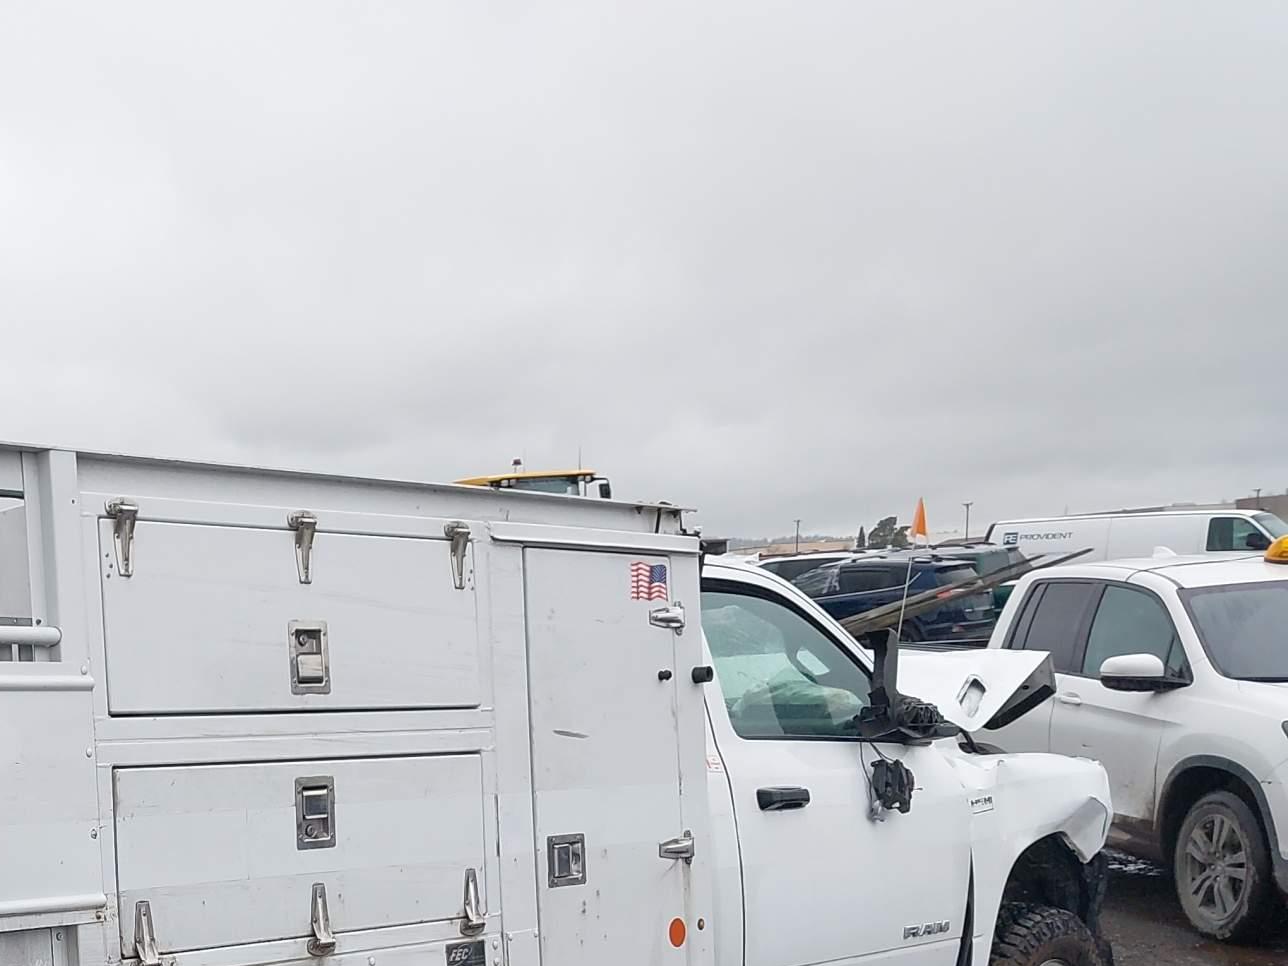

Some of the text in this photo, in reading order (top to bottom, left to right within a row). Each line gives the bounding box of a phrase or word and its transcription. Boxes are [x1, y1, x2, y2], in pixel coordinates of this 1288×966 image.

[1019, 532, 1073, 541] PROVIDENT
[970, 796, 993, 807] HEMI
[903, 920, 951, 940] RAM
[449, 948, 469, 962] FEC
